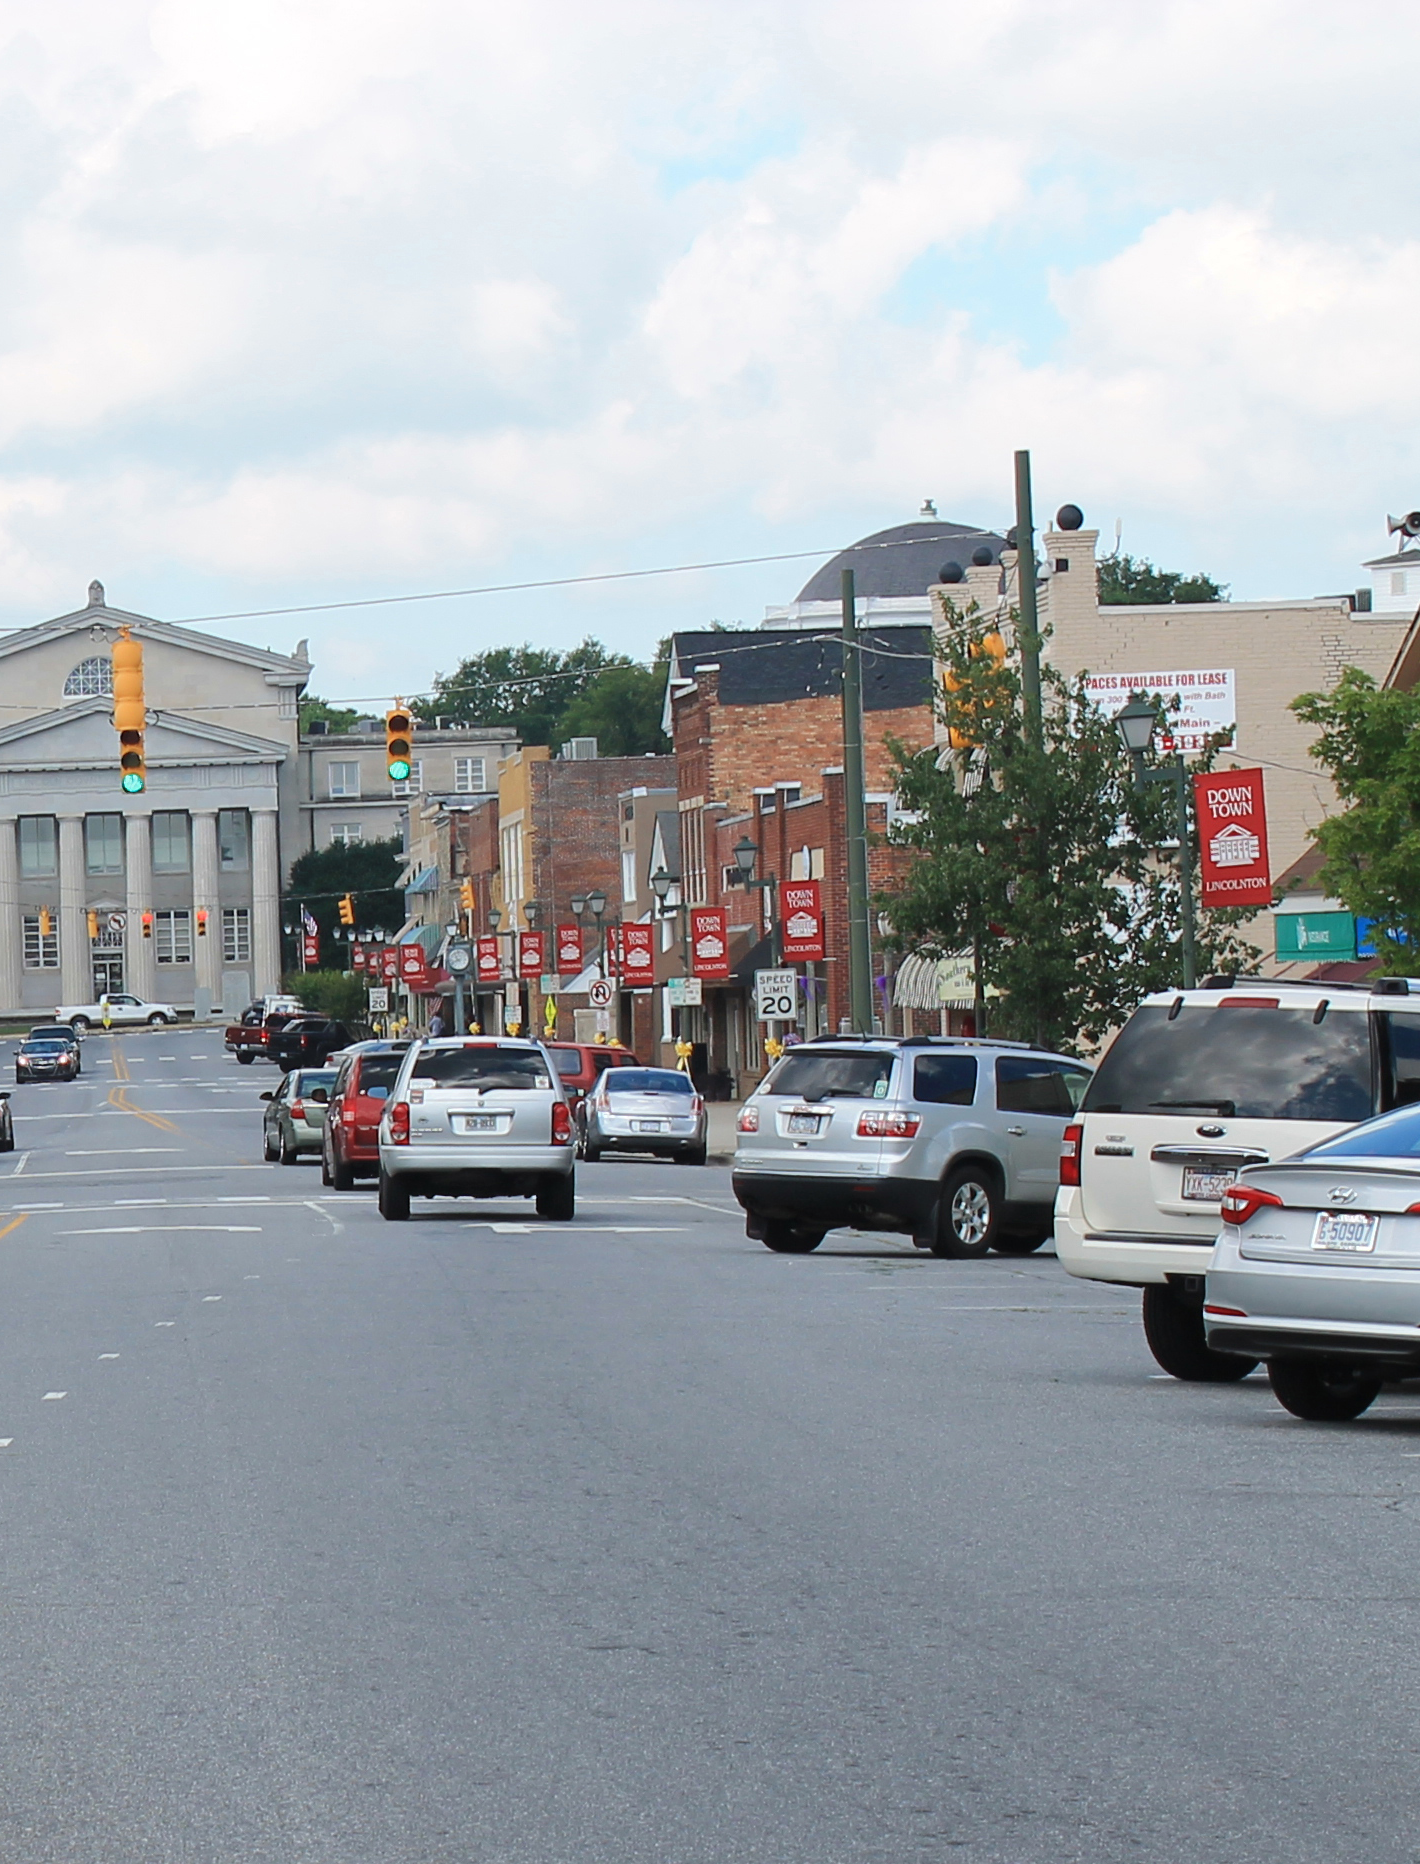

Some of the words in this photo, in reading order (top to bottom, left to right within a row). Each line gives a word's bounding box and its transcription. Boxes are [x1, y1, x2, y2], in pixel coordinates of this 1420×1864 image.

[1120, 674, 1173, 689] AVAILABLE
[1175, 673, 1195, 686] FOR
[1198, 672, 1228, 685] LEASE
[1183, 692, 1203, 701] with
[1205, 691, 1226, 700] Bath
[1180, 718, 1211, 728] Main
[1207, 786, 1252, 804] DOWN
[1209, 801, 1253, 818] TOWN
[1206, 877, 1267, 892] LINCOLNTON
[786, 890, 814, 901] DOWN
[788, 899, 814, 908] TOWN
[696, 916, 720, 925] DOWN
[698, 924, 721, 932] TOWN
[783, 945, 822, 953] LINCOLNTON
[760, 975, 793, 985] SPEED
[763, 985, 789, 995] LIMIT
[371, 1000, 386, 1009] 20
[761, 995, 792, 1015] 20
